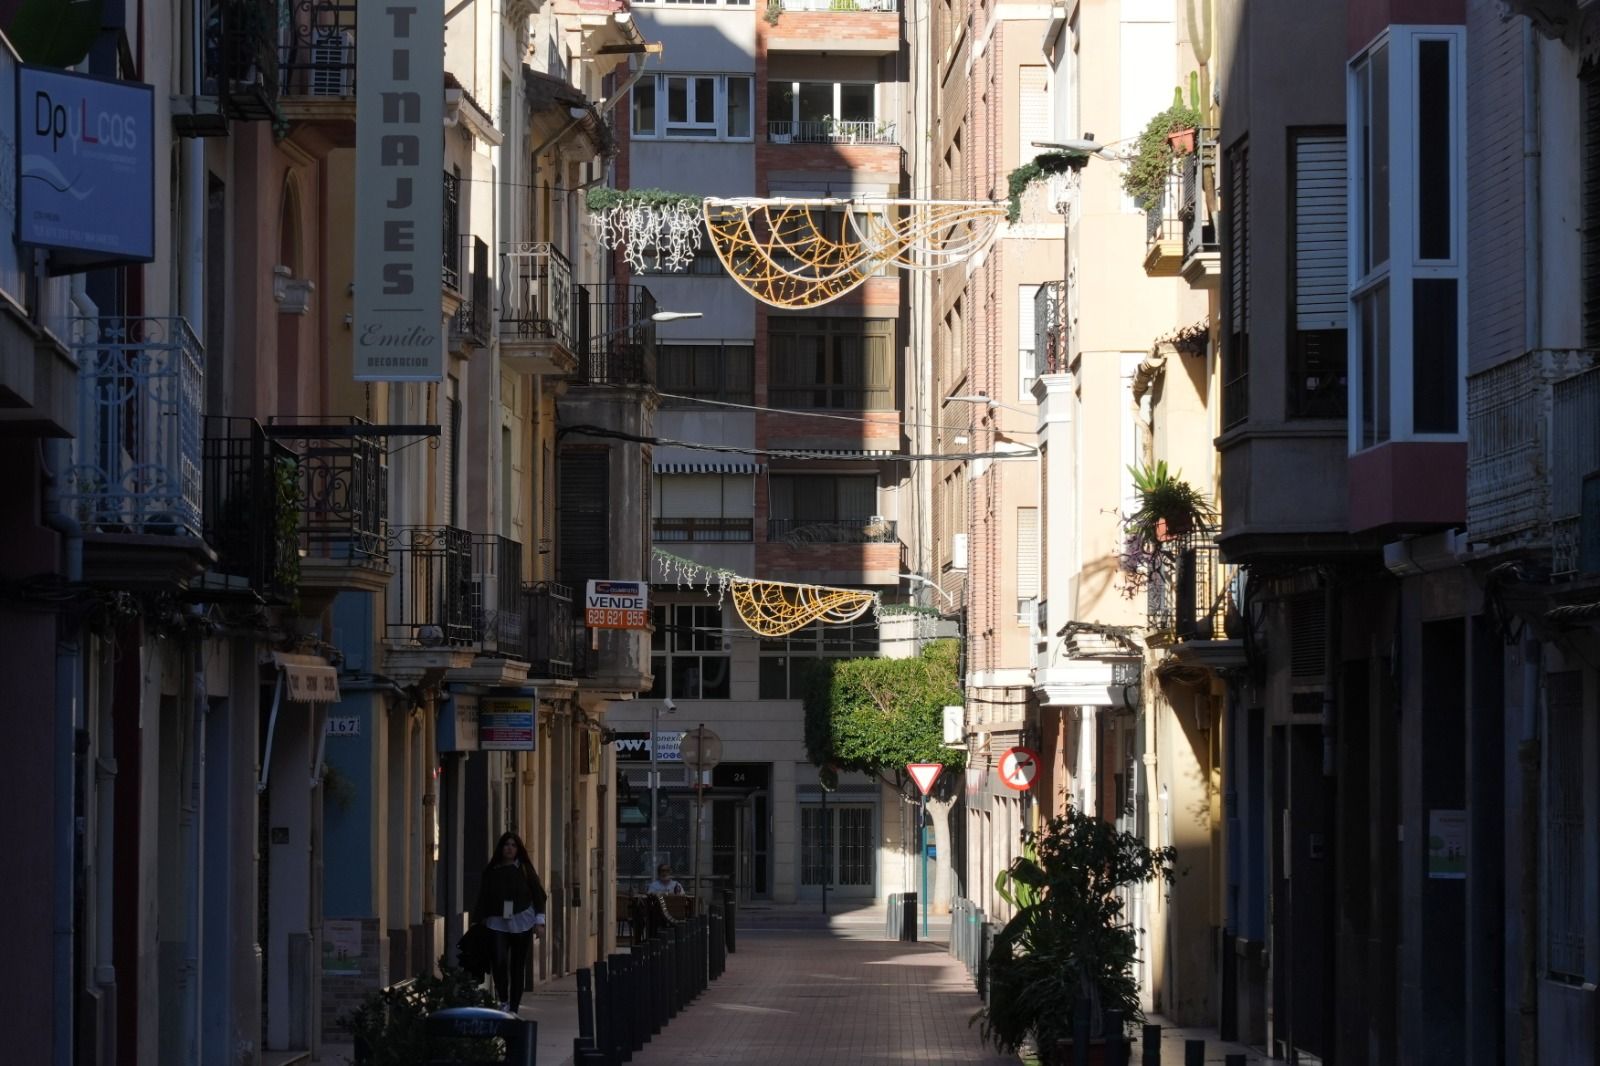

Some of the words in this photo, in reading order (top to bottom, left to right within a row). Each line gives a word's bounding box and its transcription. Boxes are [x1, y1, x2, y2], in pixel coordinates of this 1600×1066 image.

[360, 324, 435, 347] Emilio
[589, 596, 643, 609] VENDE
[588, 609, 605, 625] 629
[607, 610, 624, 625] 621
[626, 611, 644, 626] 955
[330, 720, 355, 732] 167
[733, 773, 745, 782] 24
